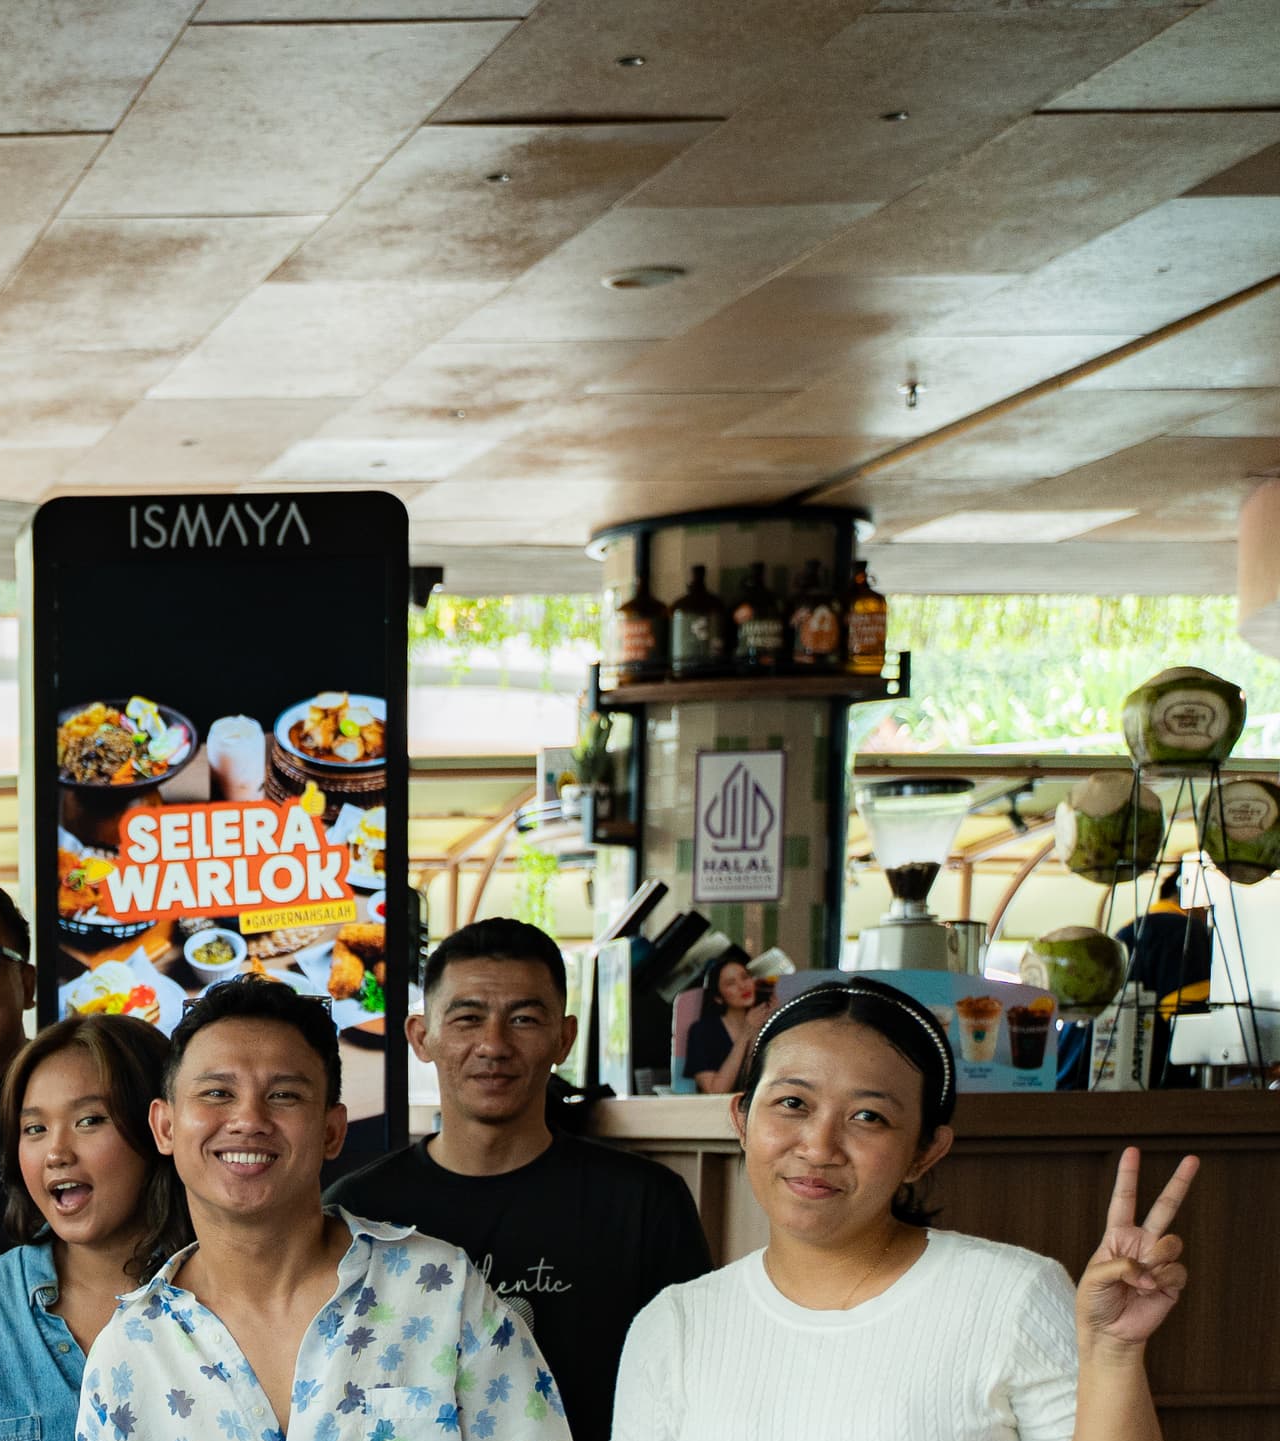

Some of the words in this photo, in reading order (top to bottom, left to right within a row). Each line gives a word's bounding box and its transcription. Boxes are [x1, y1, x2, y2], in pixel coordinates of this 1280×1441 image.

[129, 502, 310, 549] ISMAYA
[126, 807, 320, 864] SELERA
[107, 852, 348, 914] WARLOK
[703, 856, 772, 873] HALAL
